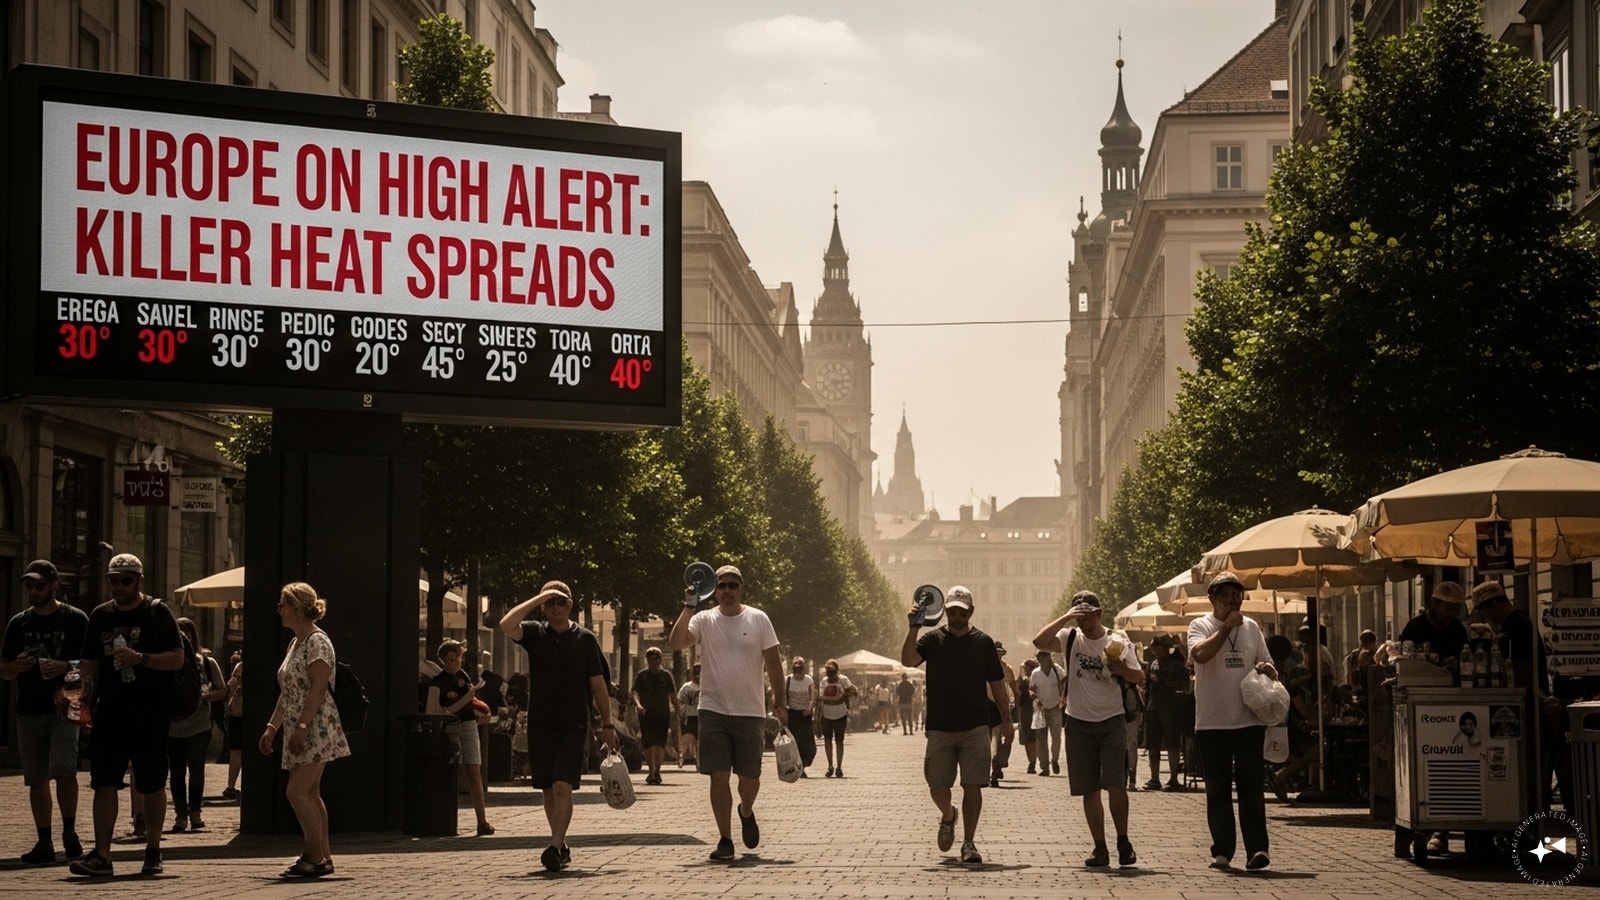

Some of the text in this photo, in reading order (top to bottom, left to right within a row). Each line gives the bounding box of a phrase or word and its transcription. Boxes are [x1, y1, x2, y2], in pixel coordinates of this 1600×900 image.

[77, 124, 650, 236] EUROPE ON HIGH ALERT:
[77, 208, 615, 311] KILLER HEAT SPREADS
[57, 297, 120, 324] EREGA
[350, 315, 408, 342] CODES
[422, 320, 467, 345] SECY
[549, 328, 592, 352] TORA
[610, 332, 652, 357] ORTA
[58, 323, 652, 390] 30° 30° 30° 30° 20° 45° 25° 40° 40°
